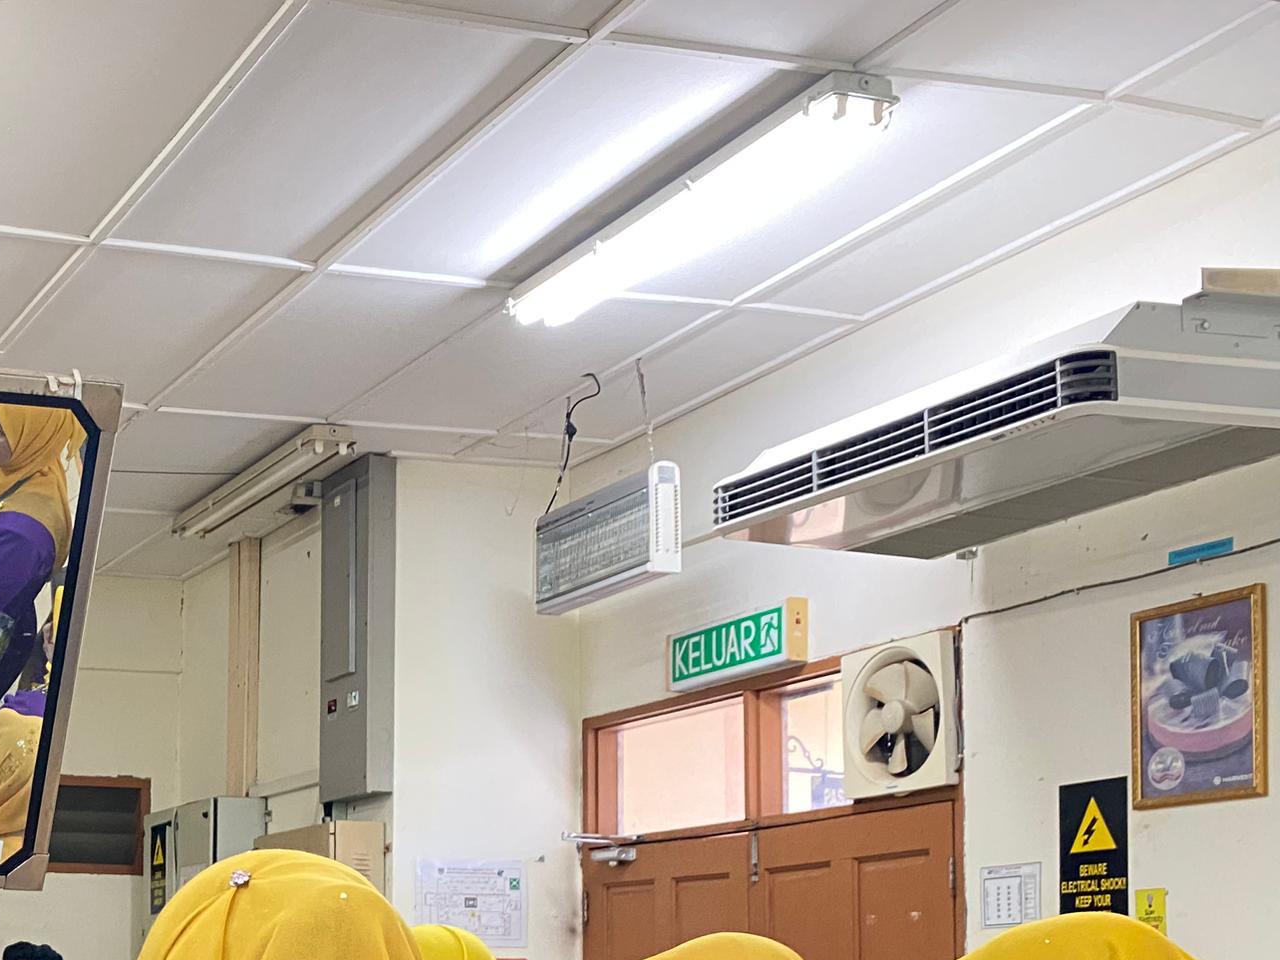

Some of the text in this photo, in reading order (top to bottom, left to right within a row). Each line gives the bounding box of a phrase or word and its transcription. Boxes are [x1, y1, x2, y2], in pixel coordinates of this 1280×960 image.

[675, 620, 755, 677] KELUAR
[1079, 862, 1108, 877] BEWARE
[1061, 879, 1099, 893] ELECTRICAL
[1075, 893, 1112, 908] KEEP YOUR
